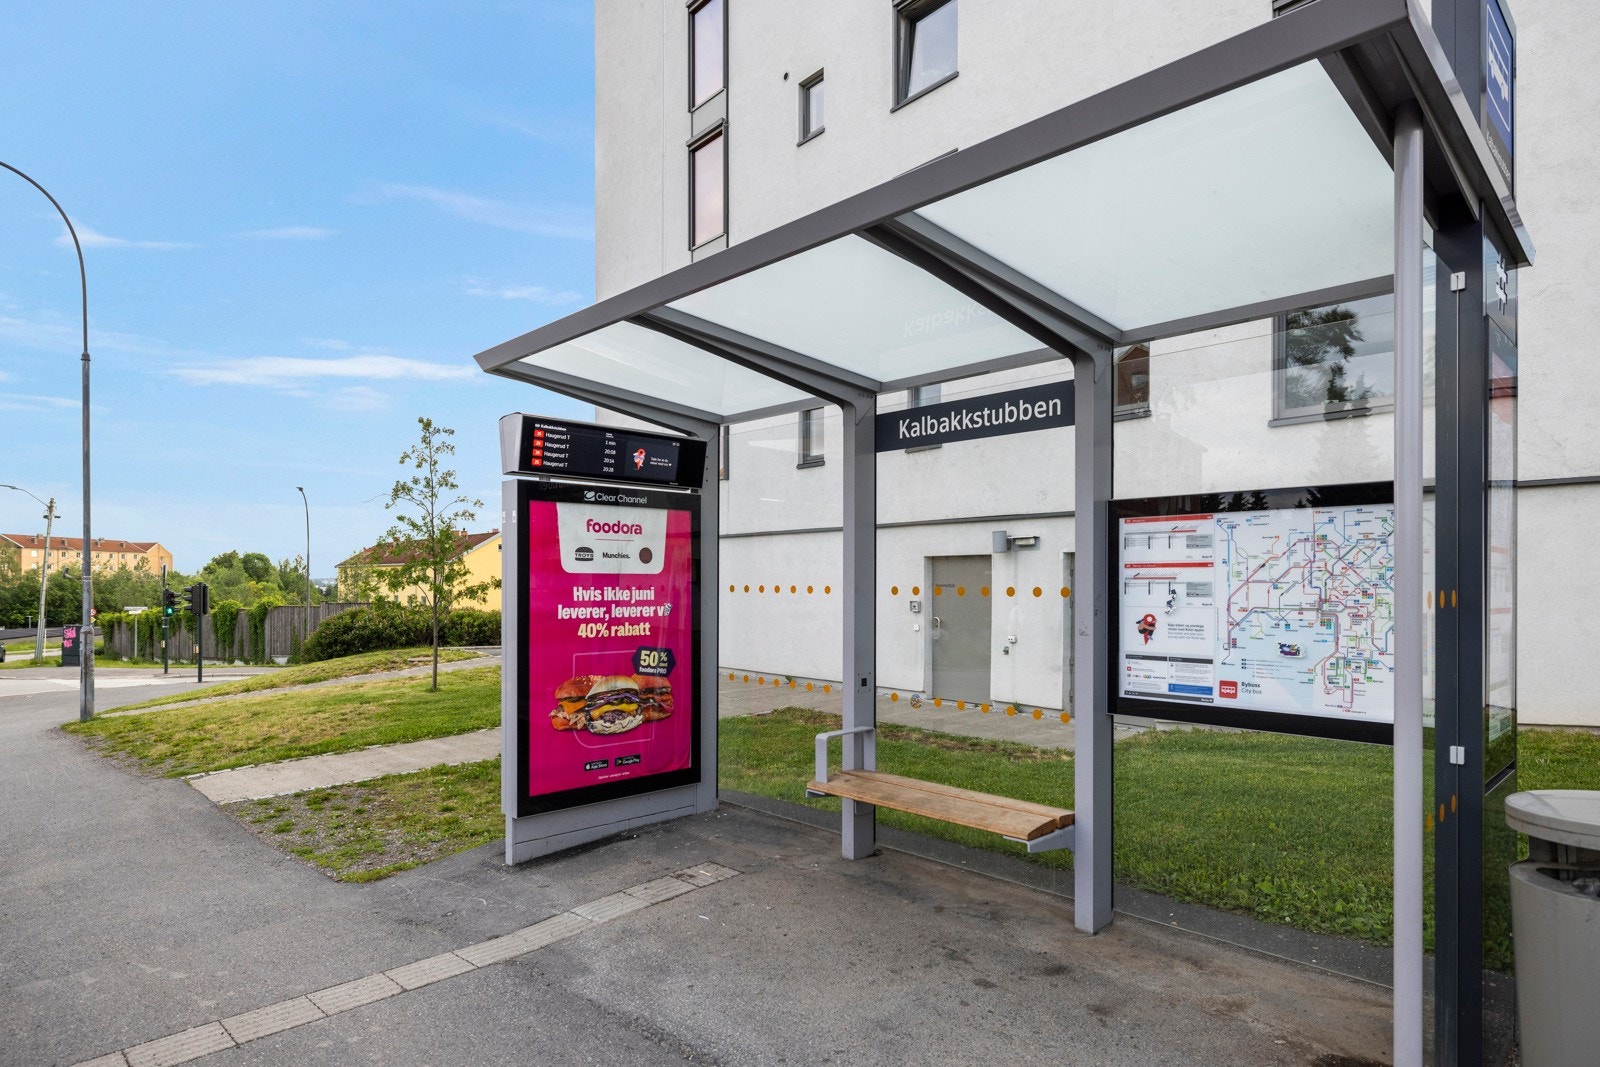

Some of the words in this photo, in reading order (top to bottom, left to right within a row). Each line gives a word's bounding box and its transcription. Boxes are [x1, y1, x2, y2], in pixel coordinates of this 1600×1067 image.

[899, 398, 1062, 439] Kalbakkstubben
[545, 432, 567, 440] Haugerud
[544, 441, 566, 449] Haugerud
[543, 451, 565, 459] Haugerud
[542, 460, 564, 468] Haugerud
[596, 492, 616, 502] Clear
[617, 494, 648, 504] Channel
[586, 518, 643, 535] foodora
[573, 586, 603, 602] Hvis
[604, 587, 631, 602] ikke
[631, 586, 655, 604] juni
[558, 603, 610, 621] leverer,
[611, 603, 655, 619] leverer
[577, 622, 609, 639] 40%
[610, 622, 651, 638] rabatt
[1241, 681, 1262, 689] Bybuss
[1241, 687, 1253, 695] City
